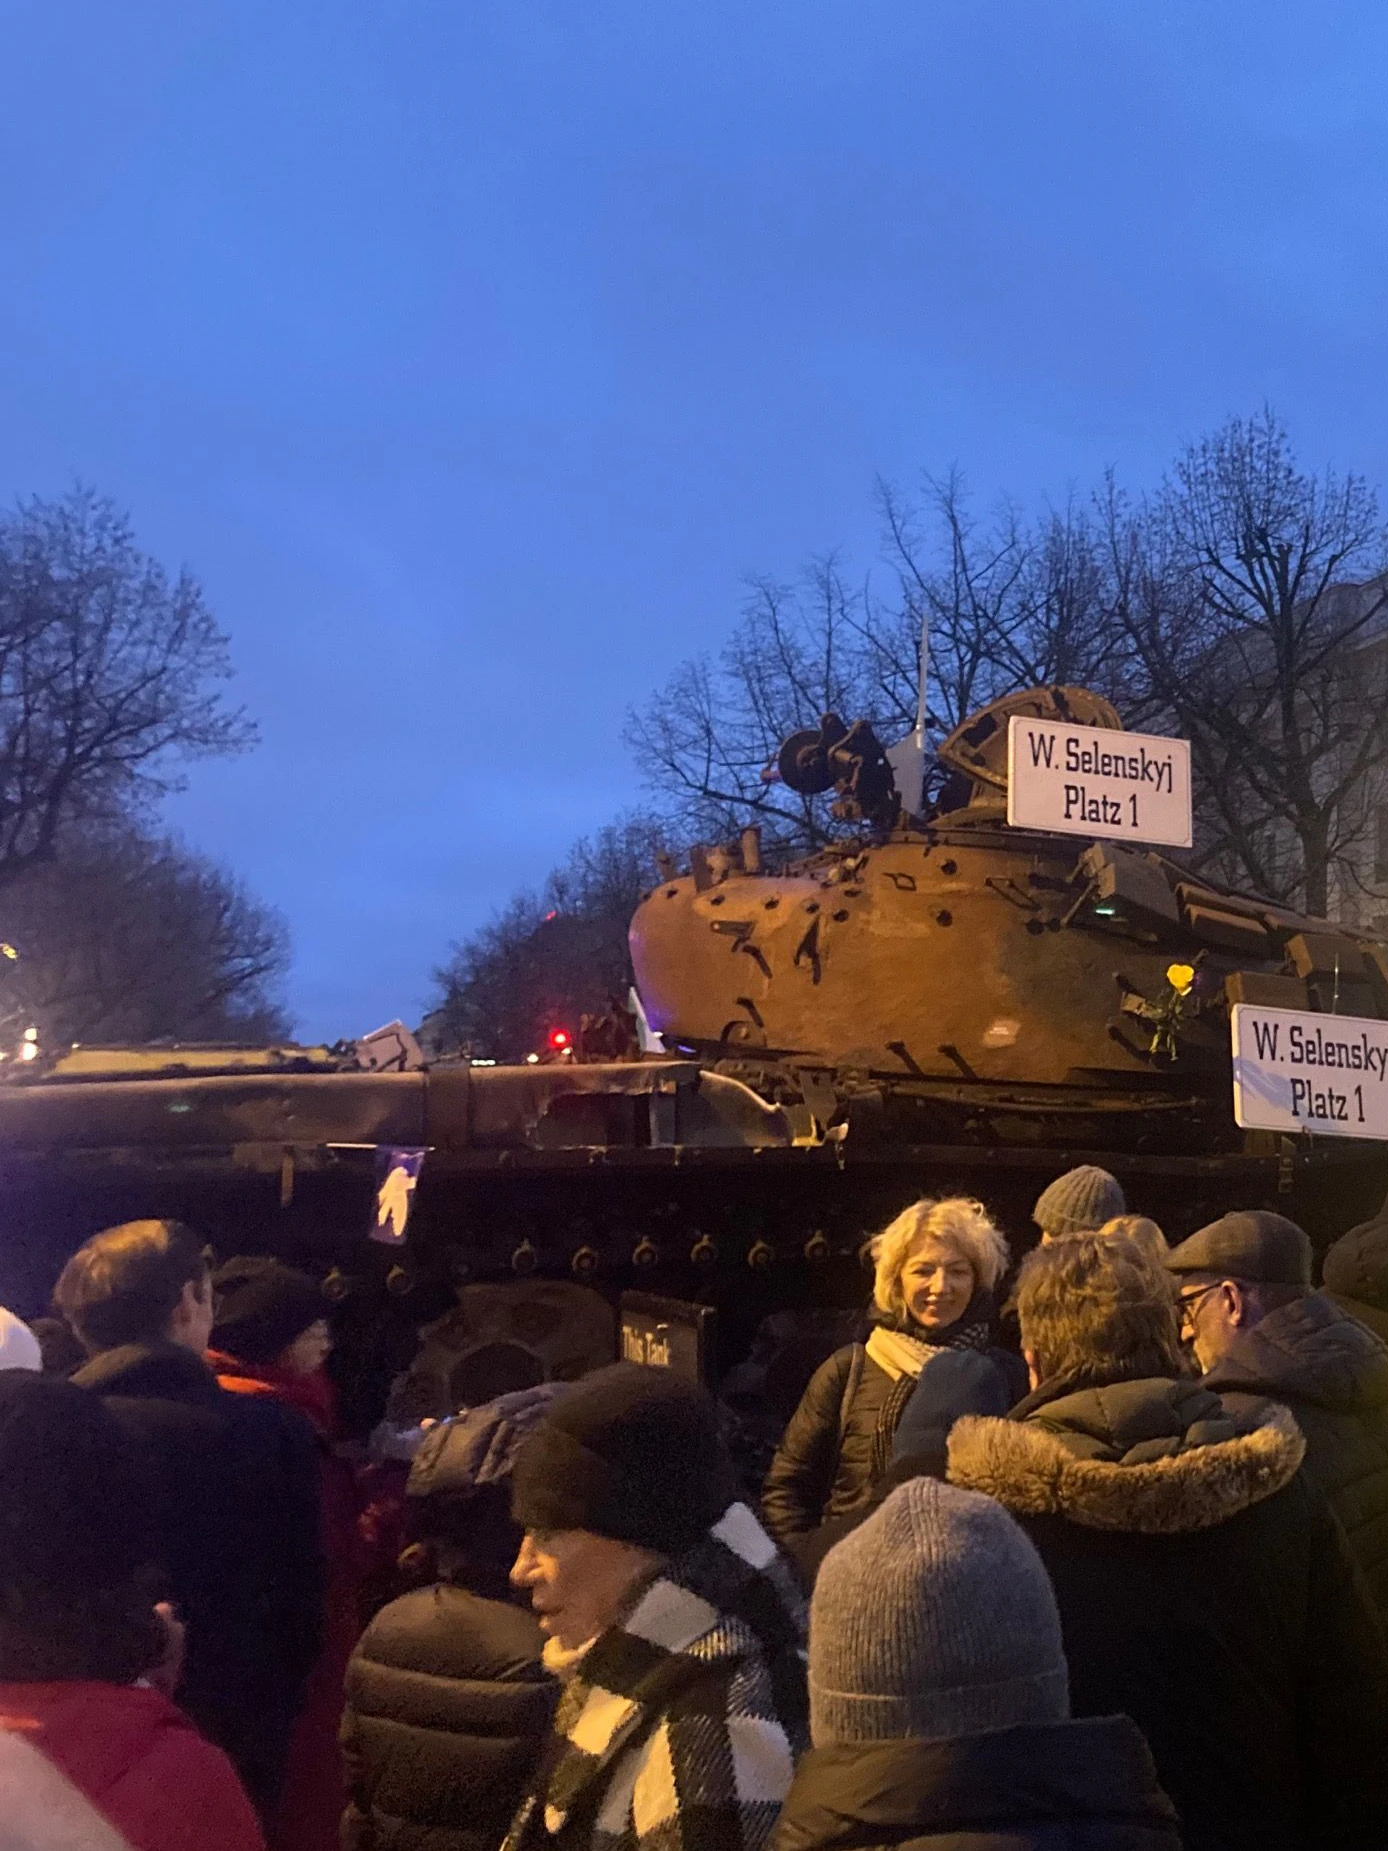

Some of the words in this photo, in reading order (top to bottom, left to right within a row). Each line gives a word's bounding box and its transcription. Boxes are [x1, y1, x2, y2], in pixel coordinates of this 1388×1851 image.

[1028, 731, 1059, 770] W.
[1065, 737, 1173, 793] Selenskyj
[1063, 784, 1122, 825] Platz
[1129, 793, 1139, 828] 1
[1252, 1020, 1284, 1062] W.
[1290, 1078, 1349, 1121] Platz
[1354, 1084, 1365, 1122] 1
